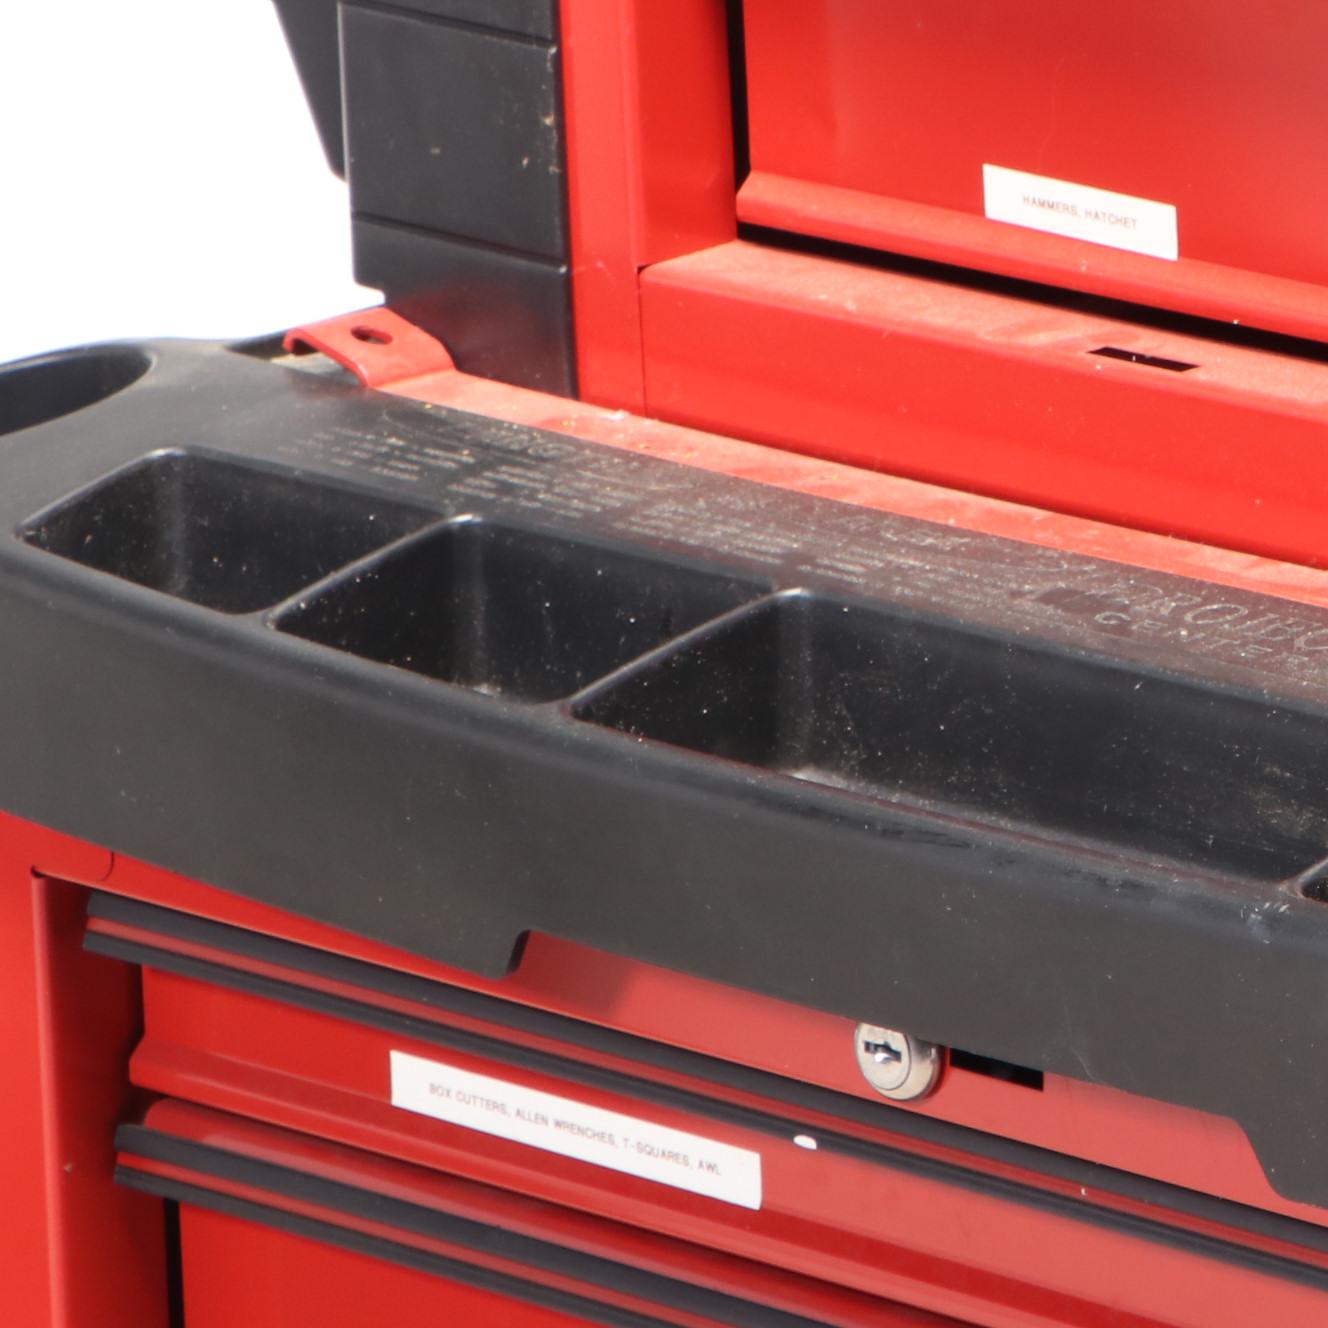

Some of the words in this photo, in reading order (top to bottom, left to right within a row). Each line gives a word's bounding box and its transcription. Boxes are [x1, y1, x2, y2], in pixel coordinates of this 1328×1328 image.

[1022, 194, 1082, 219] HAMMERS,
[1085, 208, 1138, 230] HATCHET
[429, 1082, 453, 1099] BOX
[456, 1090, 512, 1118] CUTTERS,
[515, 1107, 550, 1127] ALLEN
[553, 1117, 619, 1149] WRENCHES,
[622, 1138, 694, 1169] T-SQUARES,
[697, 1158, 723, 1176] AWL
